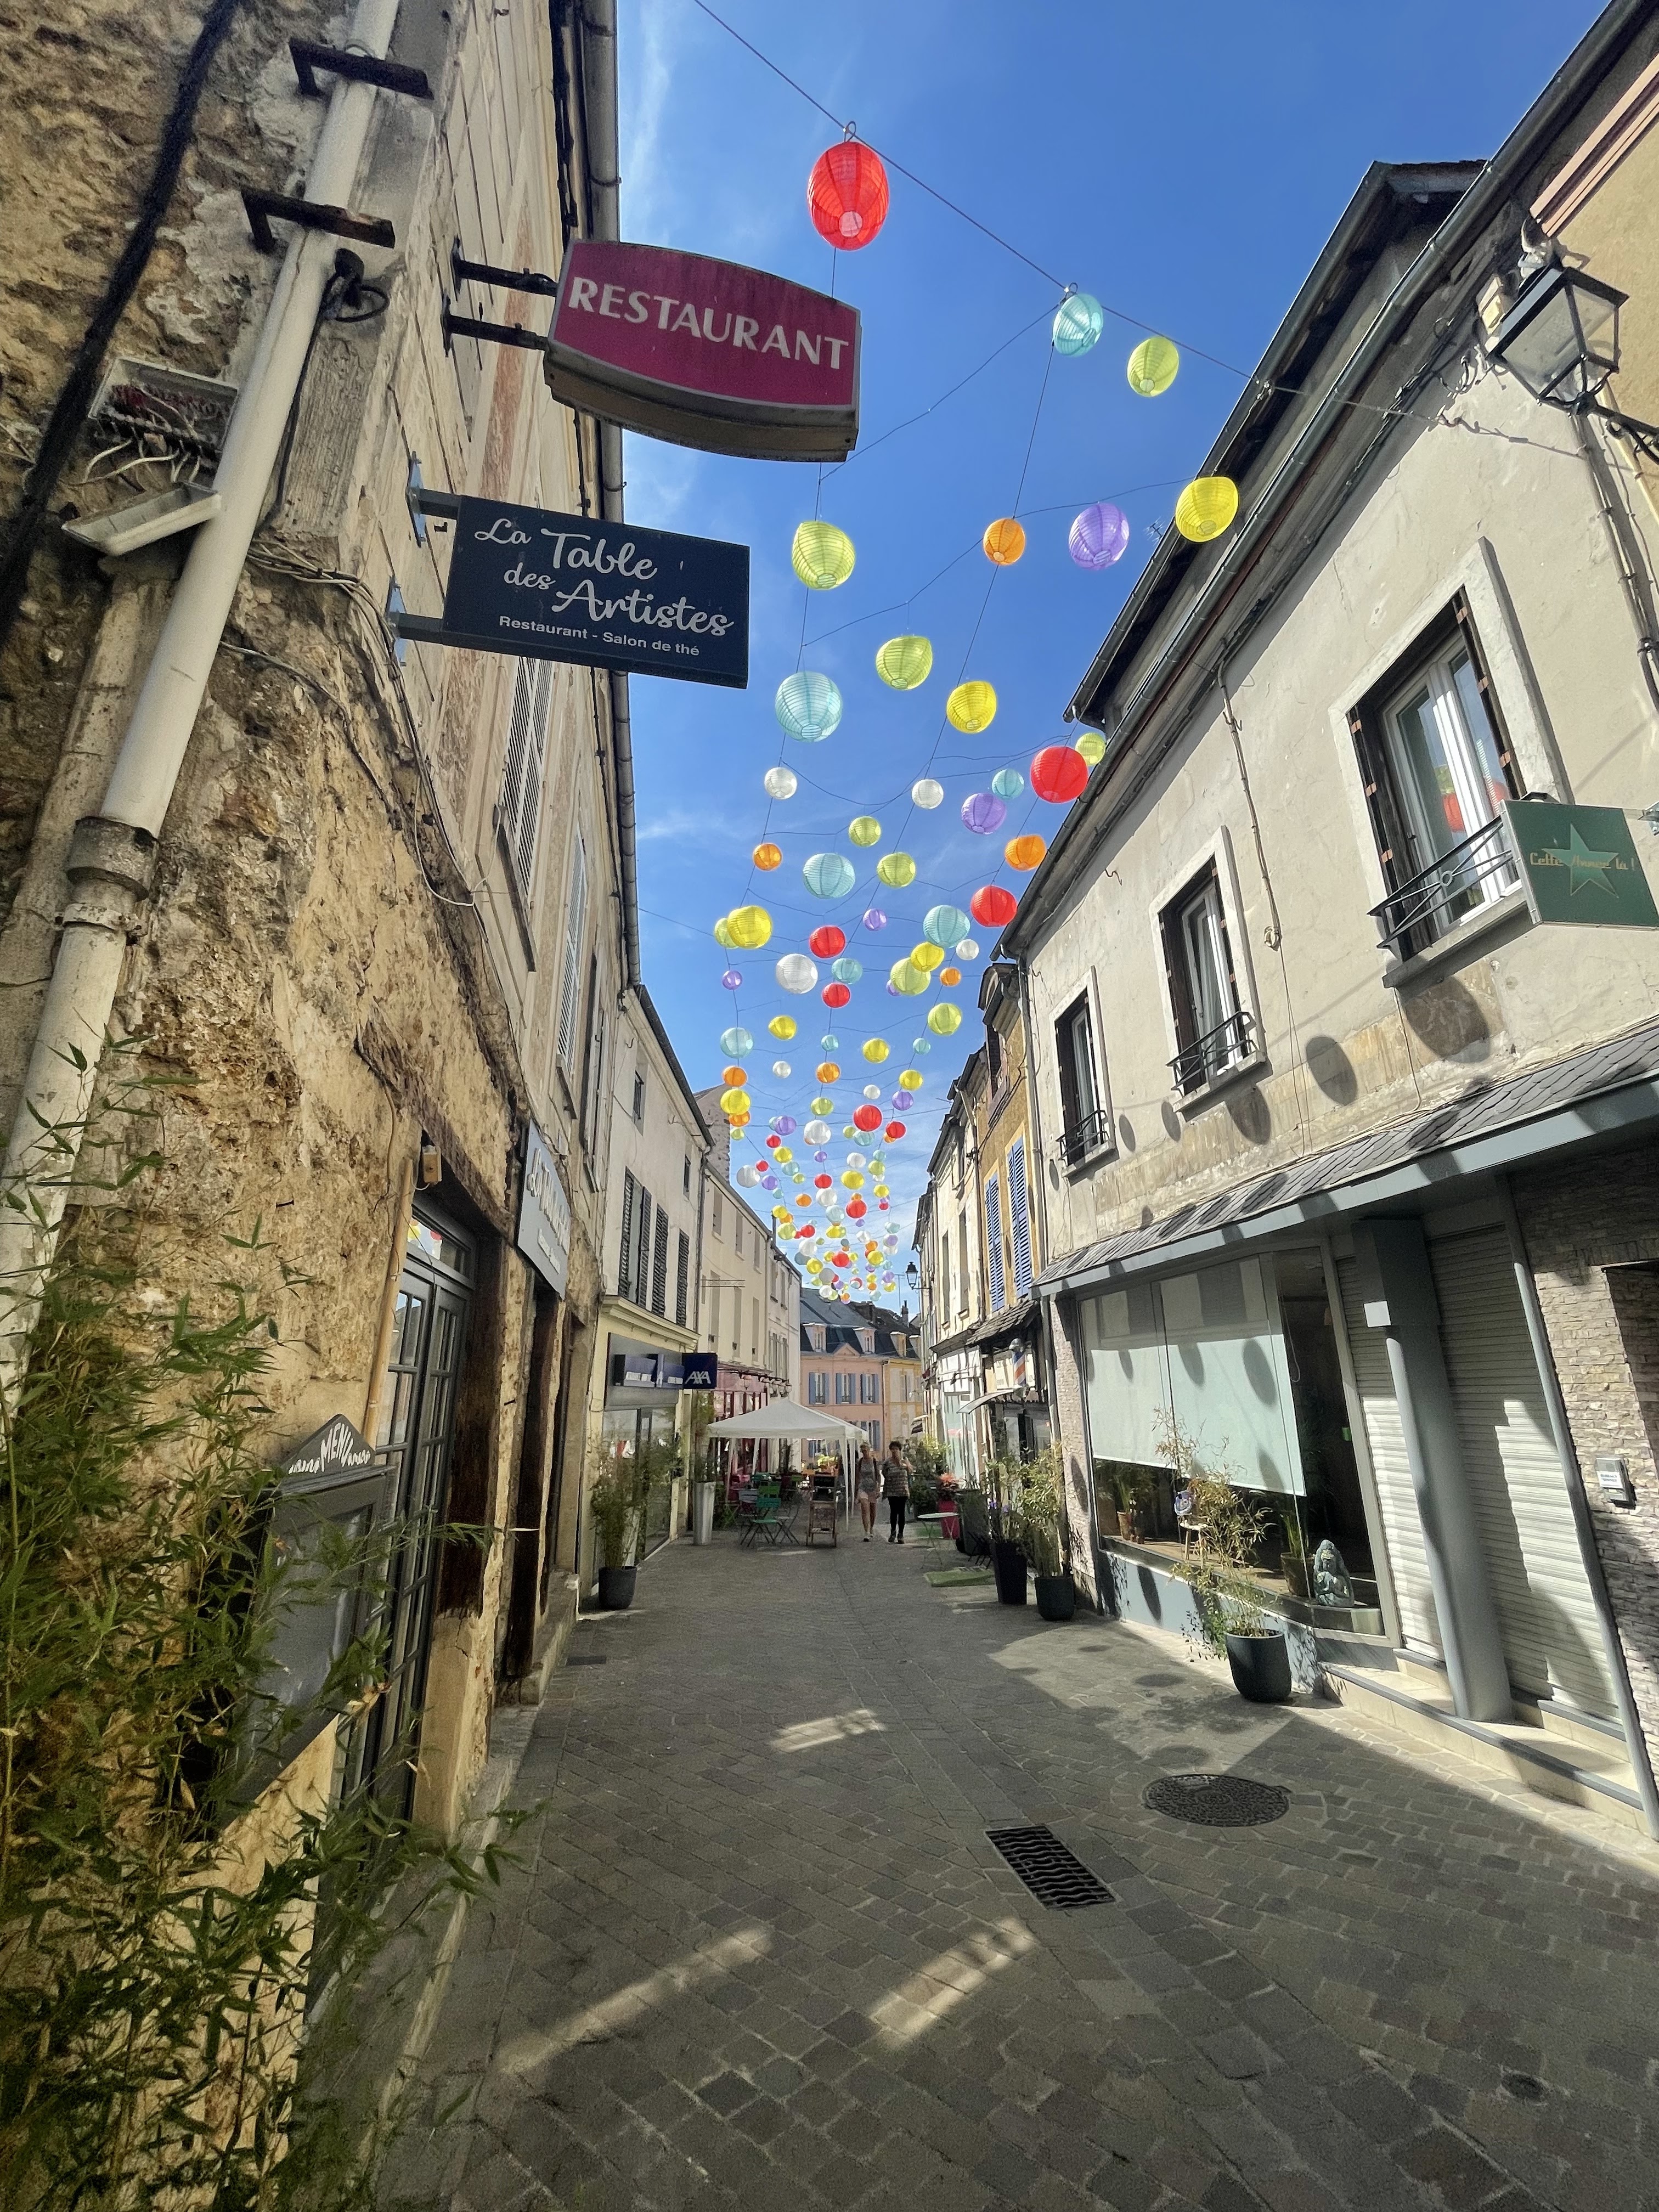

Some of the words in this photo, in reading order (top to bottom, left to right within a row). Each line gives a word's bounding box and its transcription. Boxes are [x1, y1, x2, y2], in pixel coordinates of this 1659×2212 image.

[568, 276, 849, 370] RESTAURANT
[474, 518, 532, 544] La
[540, 528, 658, 580] Table
[504, 562, 556, 590] des
[551, 579, 735, 636] Artistes
[499, 616, 588, 639] Restaurant
[602, 632, 647, 648] Salon
[652, 640, 671, 652] de
[675, 644, 700, 656] thé
[685, 1370, 712, 1385] AXA
[320, 1423, 354, 1472] MENU
